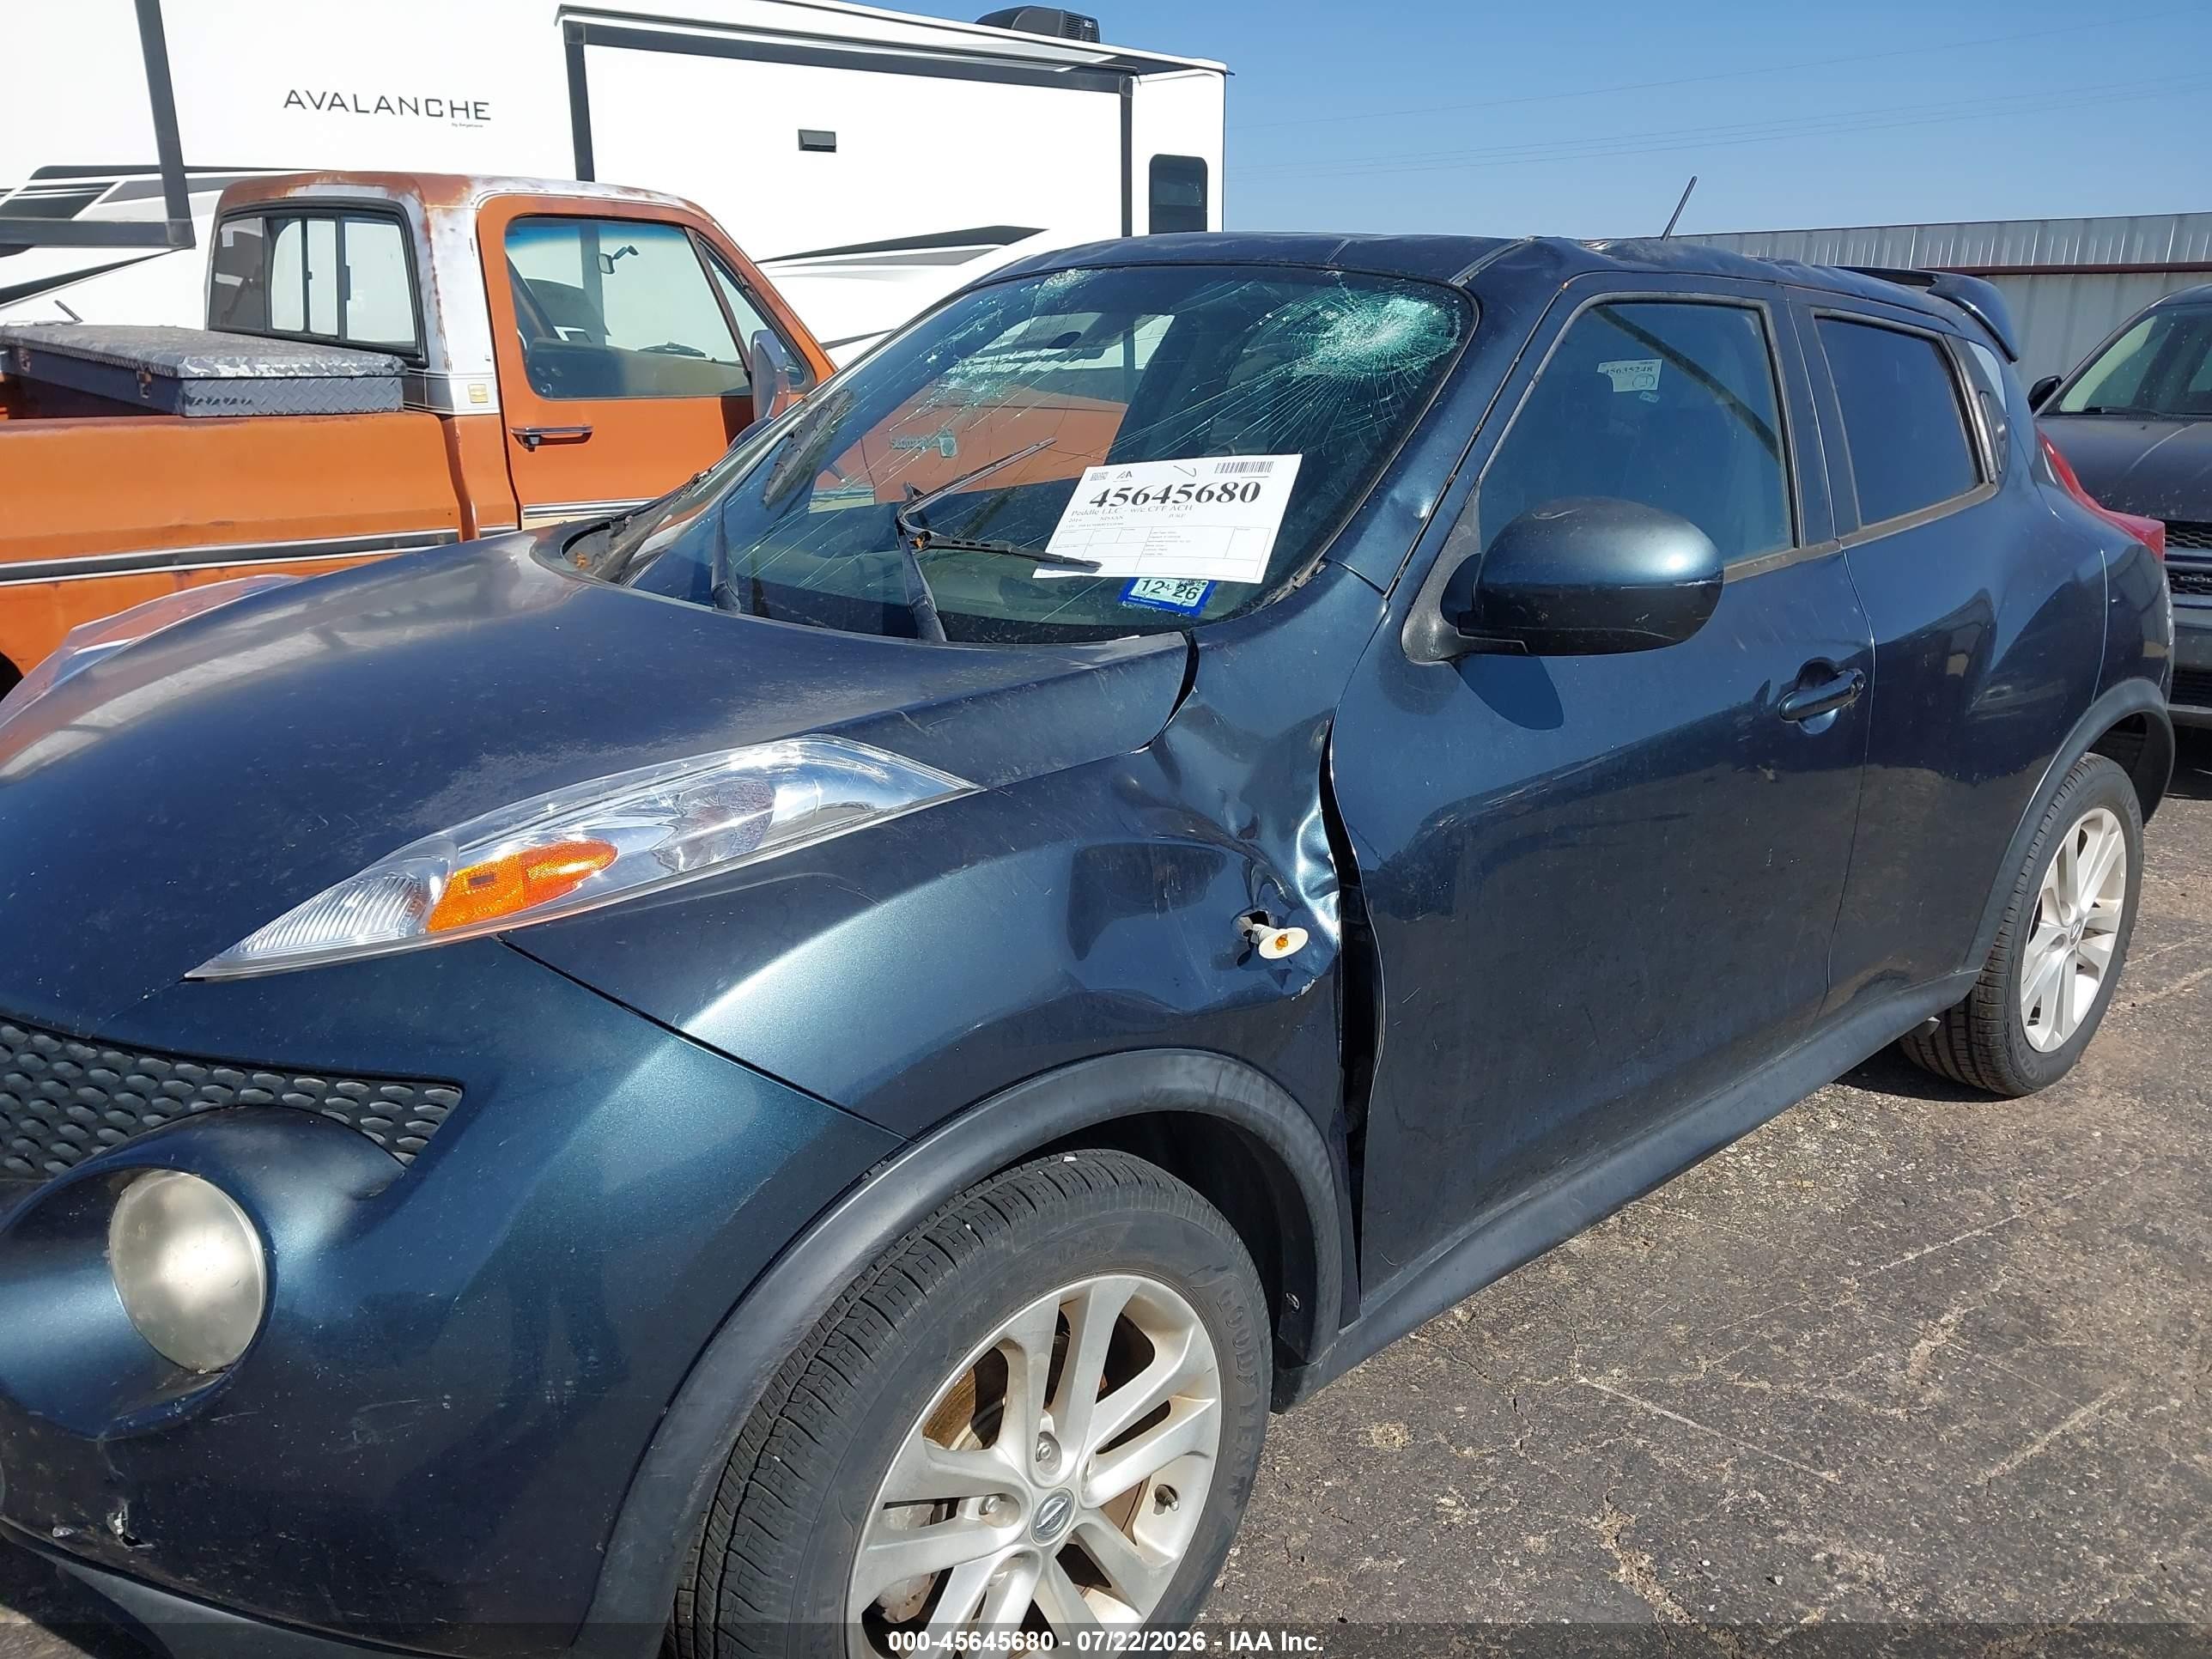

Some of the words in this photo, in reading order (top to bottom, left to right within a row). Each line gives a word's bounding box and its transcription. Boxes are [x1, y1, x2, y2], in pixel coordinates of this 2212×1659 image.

[283, 89, 492, 121] AVALANCHE
[1089, 481, 1261, 507] 45645680
[1141, 579, 1165, 594] 12
[1171, 583, 1200, 600] 26
